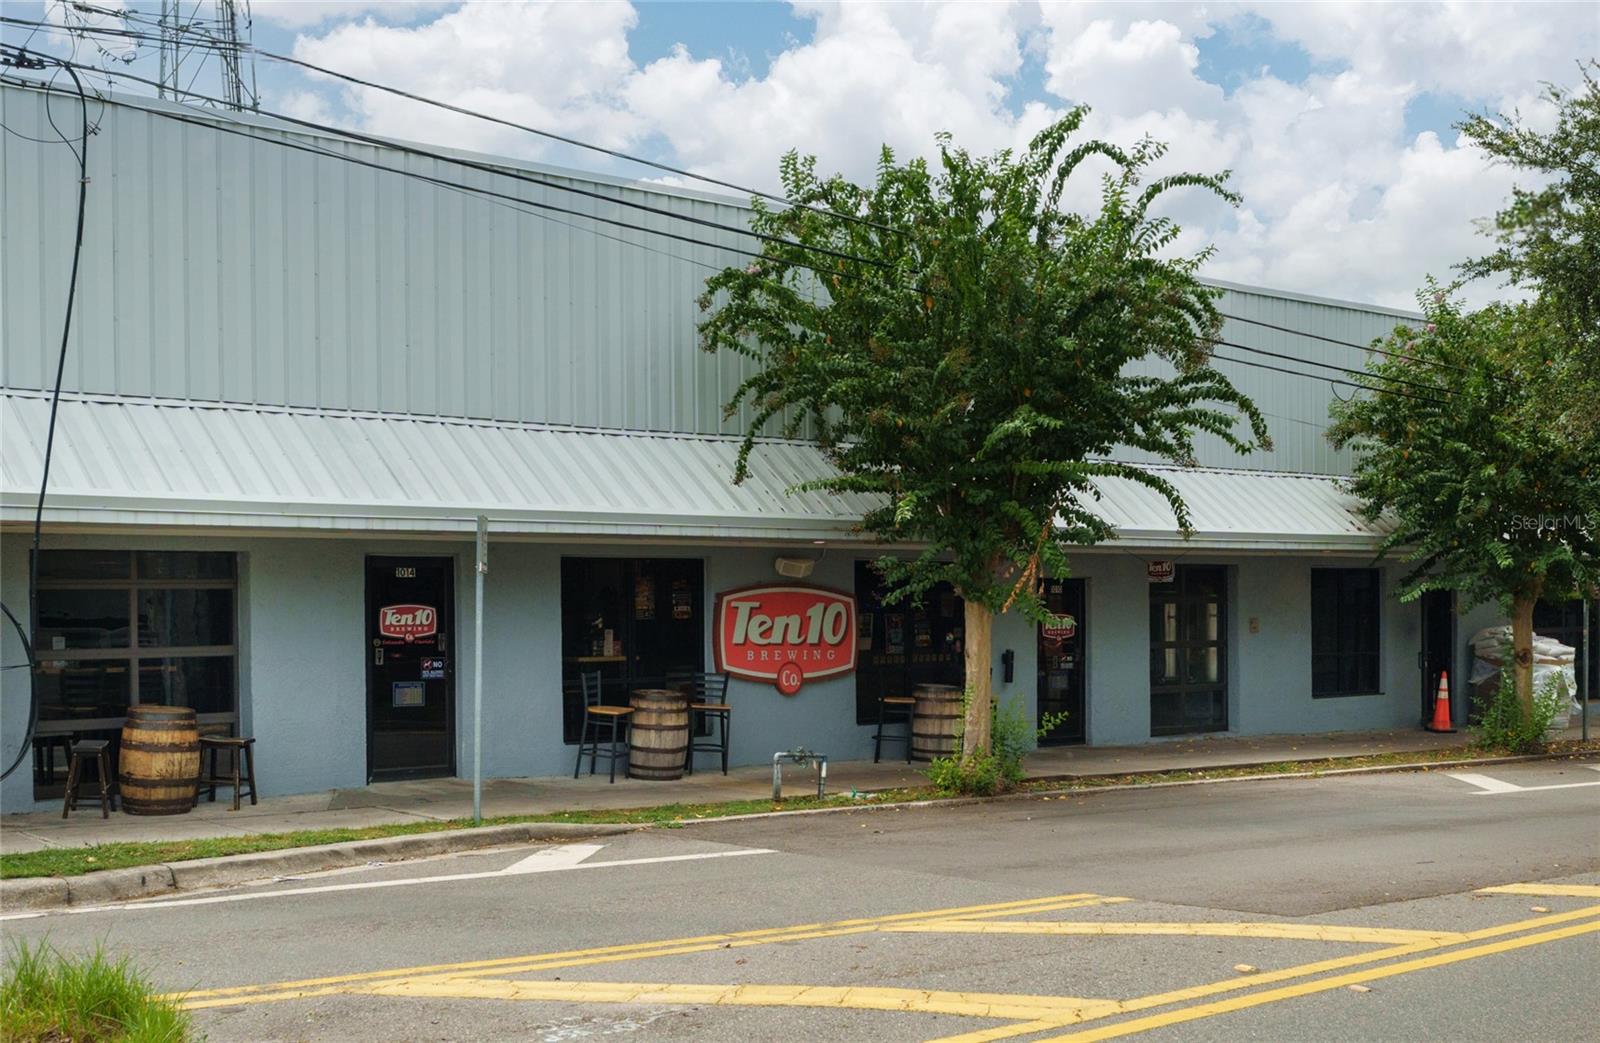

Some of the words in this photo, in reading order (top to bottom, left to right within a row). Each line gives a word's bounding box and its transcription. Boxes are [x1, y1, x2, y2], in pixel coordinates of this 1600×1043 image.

[395, 568, 416, 577] 1014
[747, 650, 836, 661] BREWING
[432, 660, 443, 668] NO
[782, 670, 800, 686] Co.
